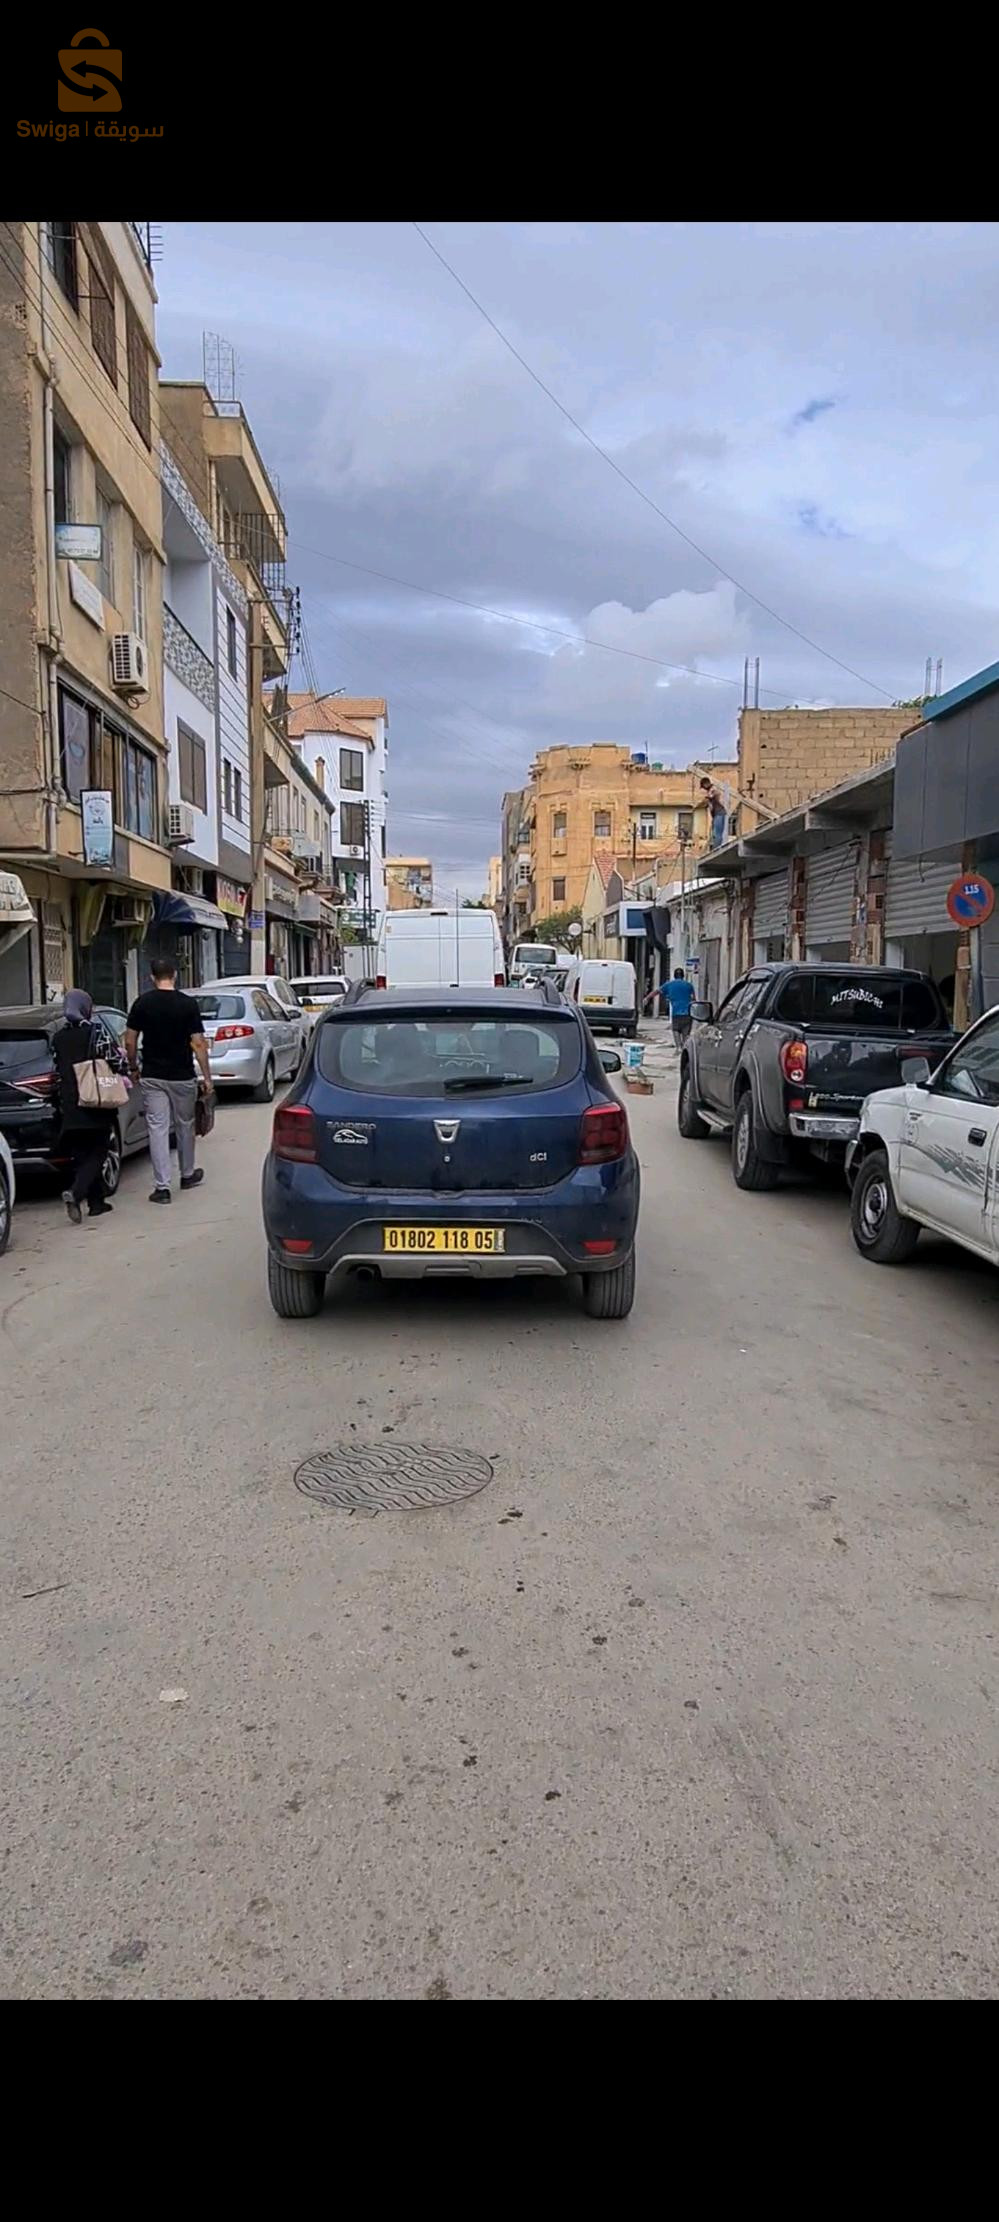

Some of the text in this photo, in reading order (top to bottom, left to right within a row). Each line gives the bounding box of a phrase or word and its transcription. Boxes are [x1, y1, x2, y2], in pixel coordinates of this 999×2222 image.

[389, 1230, 493, 1249] 01802 118 05
